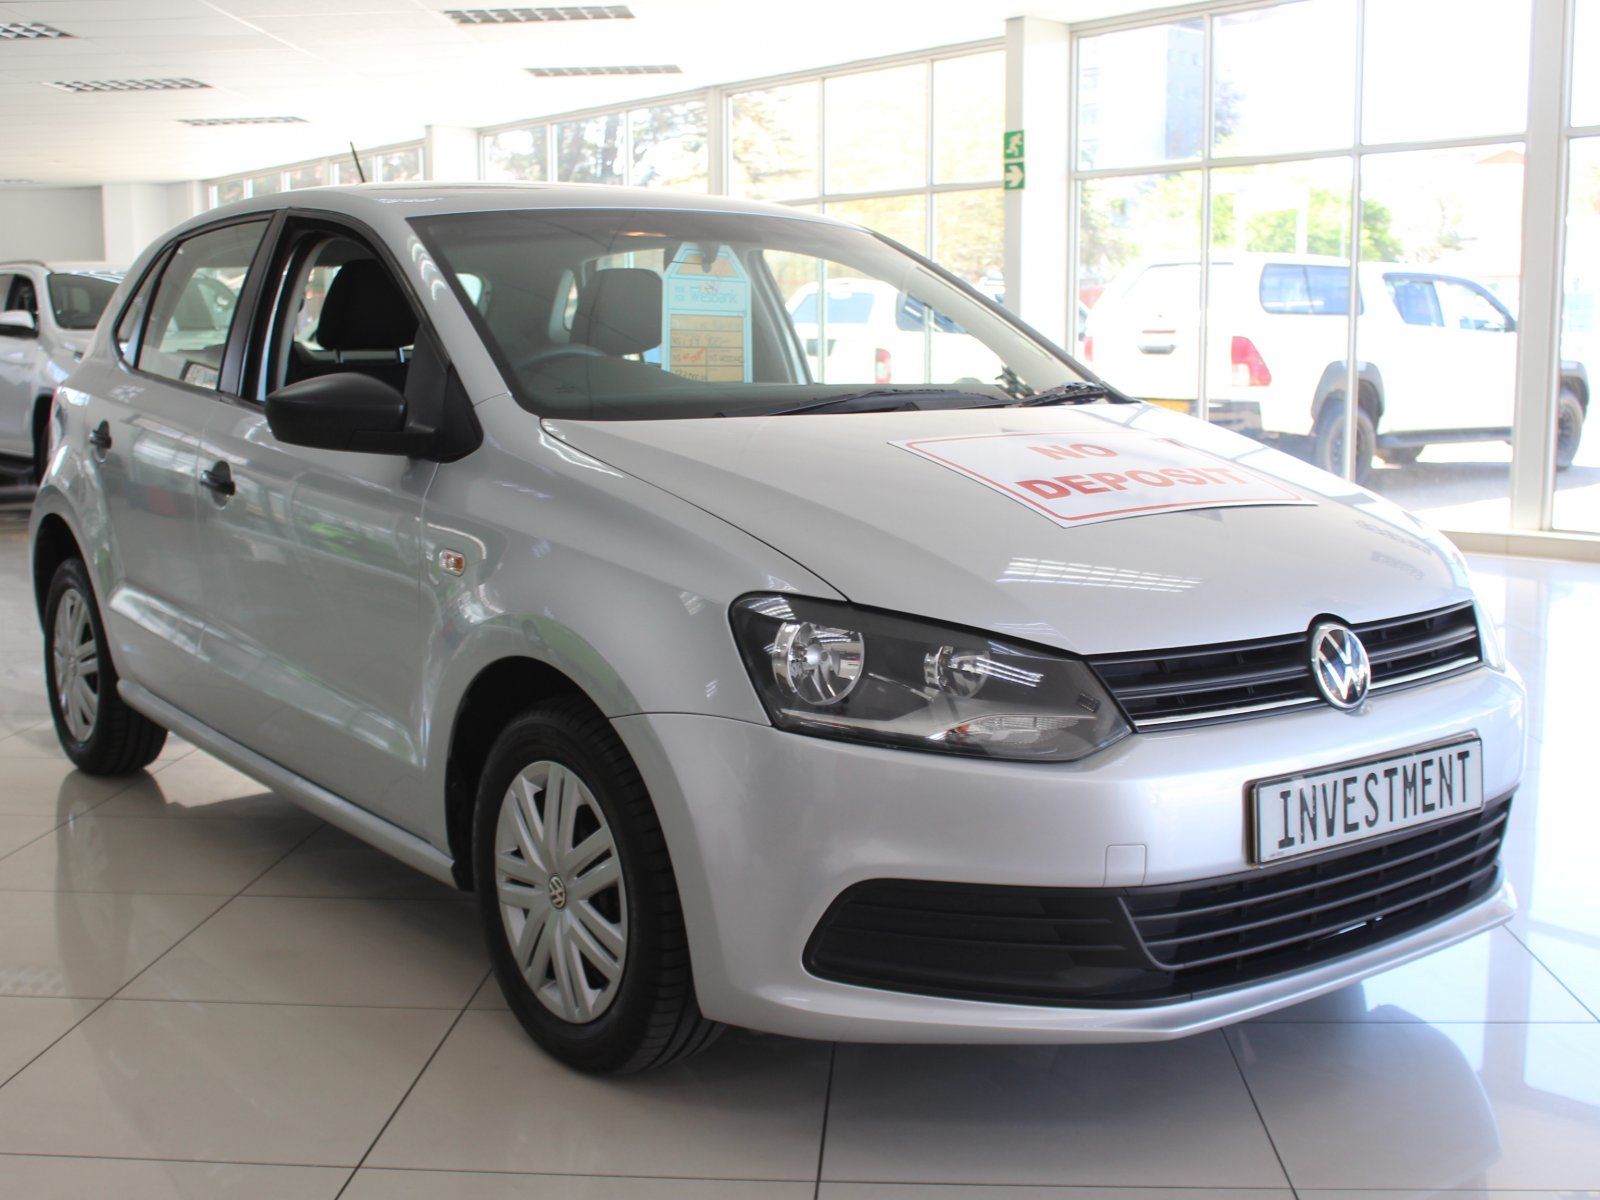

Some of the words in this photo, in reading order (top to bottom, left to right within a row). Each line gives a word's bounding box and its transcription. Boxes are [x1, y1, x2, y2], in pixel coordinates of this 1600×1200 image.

[1026, 443, 1119, 461] NO
[1014, 467, 1247, 500] DEPOSIT
[1278, 751, 1470, 850] INVESTMENT
